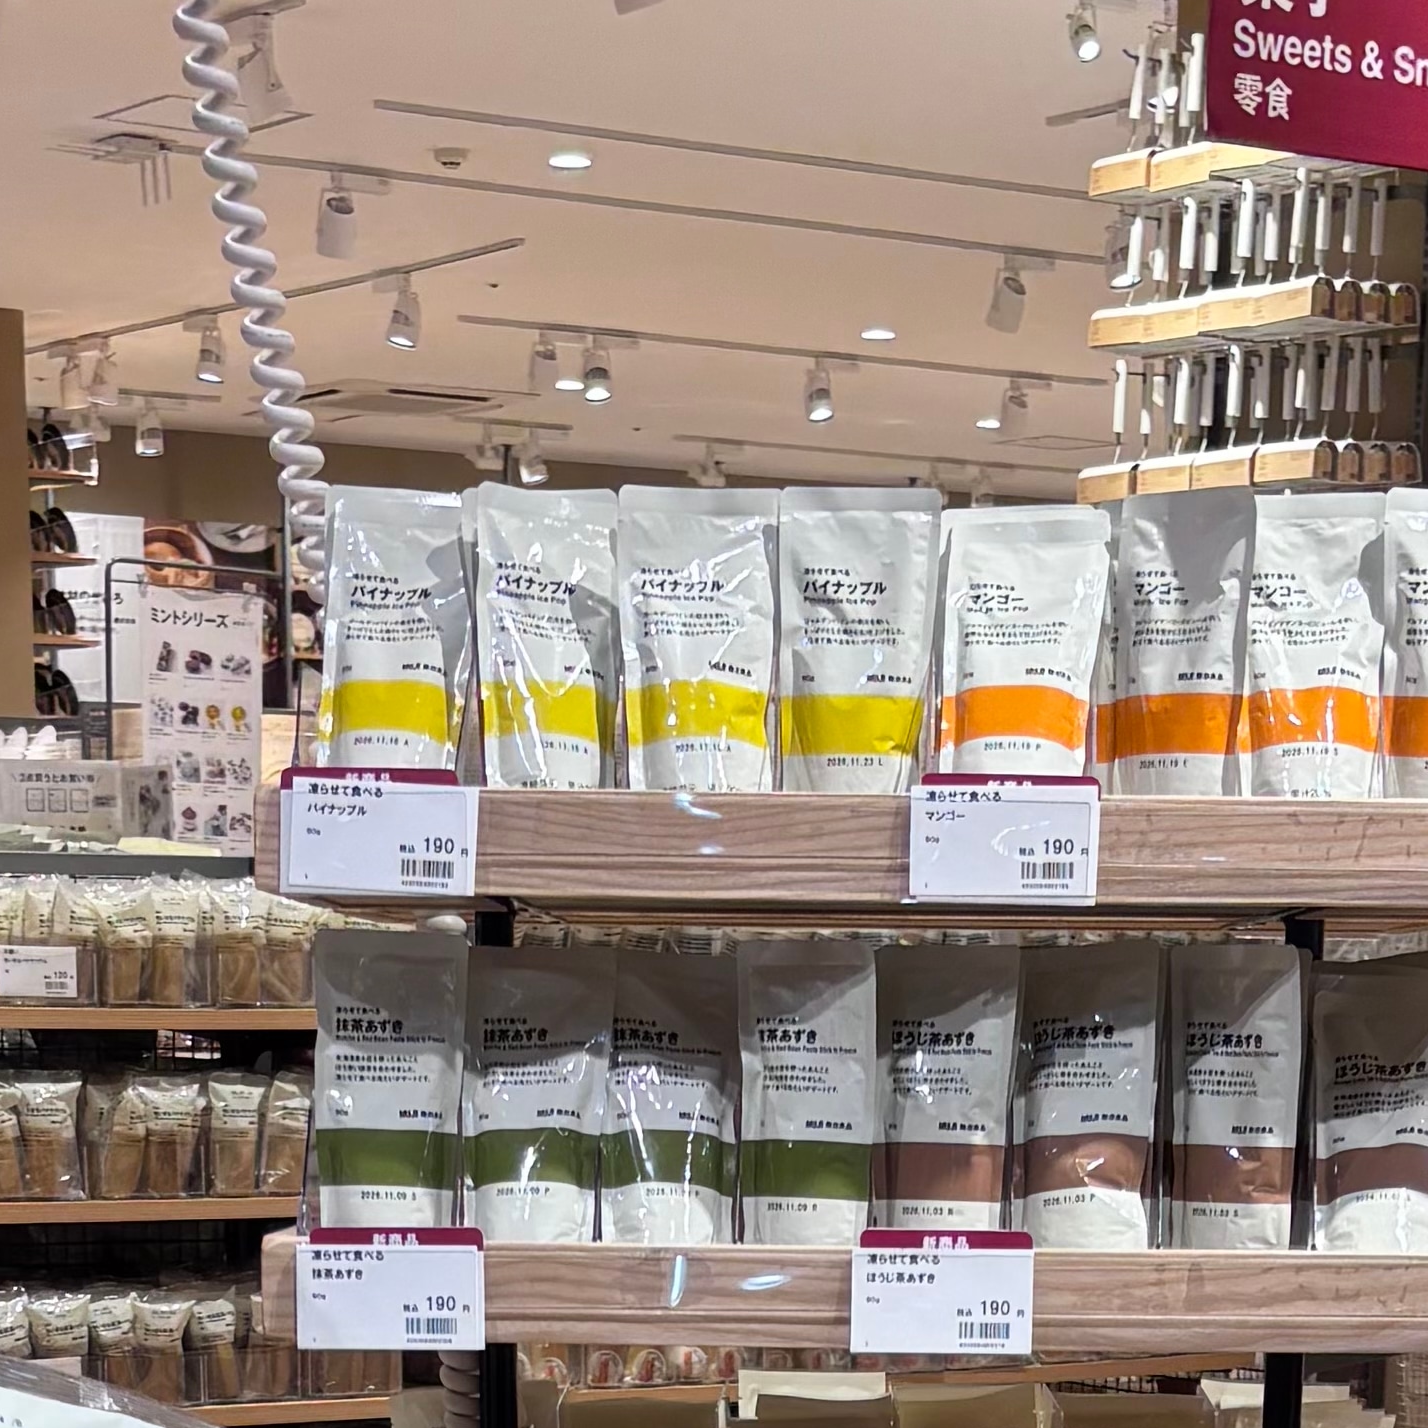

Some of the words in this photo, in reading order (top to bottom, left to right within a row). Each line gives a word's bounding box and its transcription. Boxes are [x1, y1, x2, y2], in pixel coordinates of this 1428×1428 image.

[1233, 18, 1352, 74] Sweets
[1361, 40, 1383, 80] &
[1234, 72, 1292, 121] 零食
[351, 585, 432, 601] パイナップル
[641, 579, 724, 595] パイナップル
[803, 580, 886, 596] パイナップル
[1134, 584, 1185, 596] マンゴー
[970, 593, 1024, 605] マンゴー
[151, 607, 229, 628] ミントシリーズ
[308, 783, 383, 798] 凍らせて食べる
[925, 790, 1001, 802] 凍らせて食べる
[307, 803, 367, 816] パイナップル
[925, 811, 965, 821] マンゴー
[424, 837, 454, 854] 190
[461, 849, 468, 857] 円
[1044, 839, 1074, 855] 190
[336, 1018, 403, 1034] 抹茶あずき
[483, 1028, 548, 1044] 抹茶あずき
[613, 1028, 679, 1045] 抹茶あずき
[891, 1031, 975, 1046] ほうじ茶あずき
[1034, 1025, 1115, 1046] ほうじ茶あずき
[1186, 1034, 1263, 1049] ほうじ茶あずき
[1335, 1061, 1427, 1078] ほうじ茶あずき
[312, 1250, 384, 1261] 凍らせて食べる
[867, 1254, 940, 1265] 凍らせて食べる
[312, 1268, 363, 1280] 抹茶あずき
[866, 1272, 935, 1284] ほうじ茶あずき
[426, 1296, 456, 1311] 190
[463, 1304, 470, 1313] 円
[980, 1300, 1010, 1316] 190
[1017, 1309, 1024, 1317] 円
